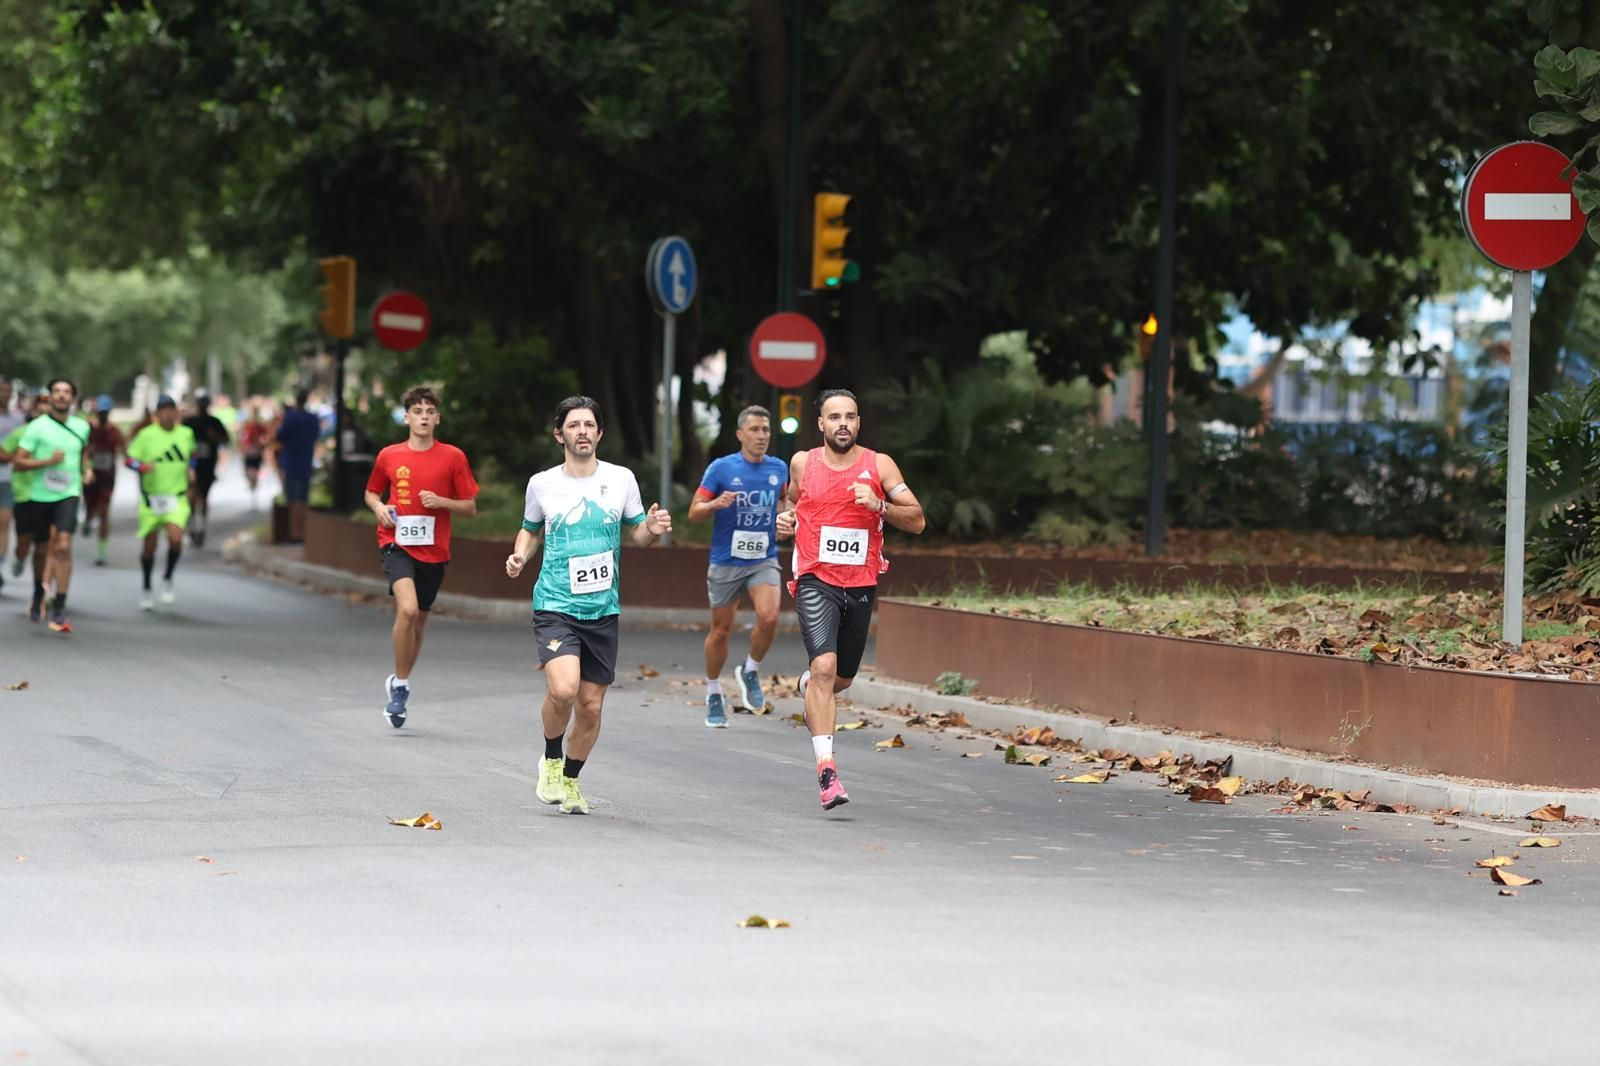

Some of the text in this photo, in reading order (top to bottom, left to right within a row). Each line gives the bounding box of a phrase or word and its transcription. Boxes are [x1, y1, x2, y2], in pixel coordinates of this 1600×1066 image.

[736, 490, 776, 507] RCM
[736, 512, 772, 526] 1873
[400, 526, 426, 536] 361
[737, 541, 763, 551] 266
[826, 539, 860, 554] 904
[576, 565, 609, 583] 218
